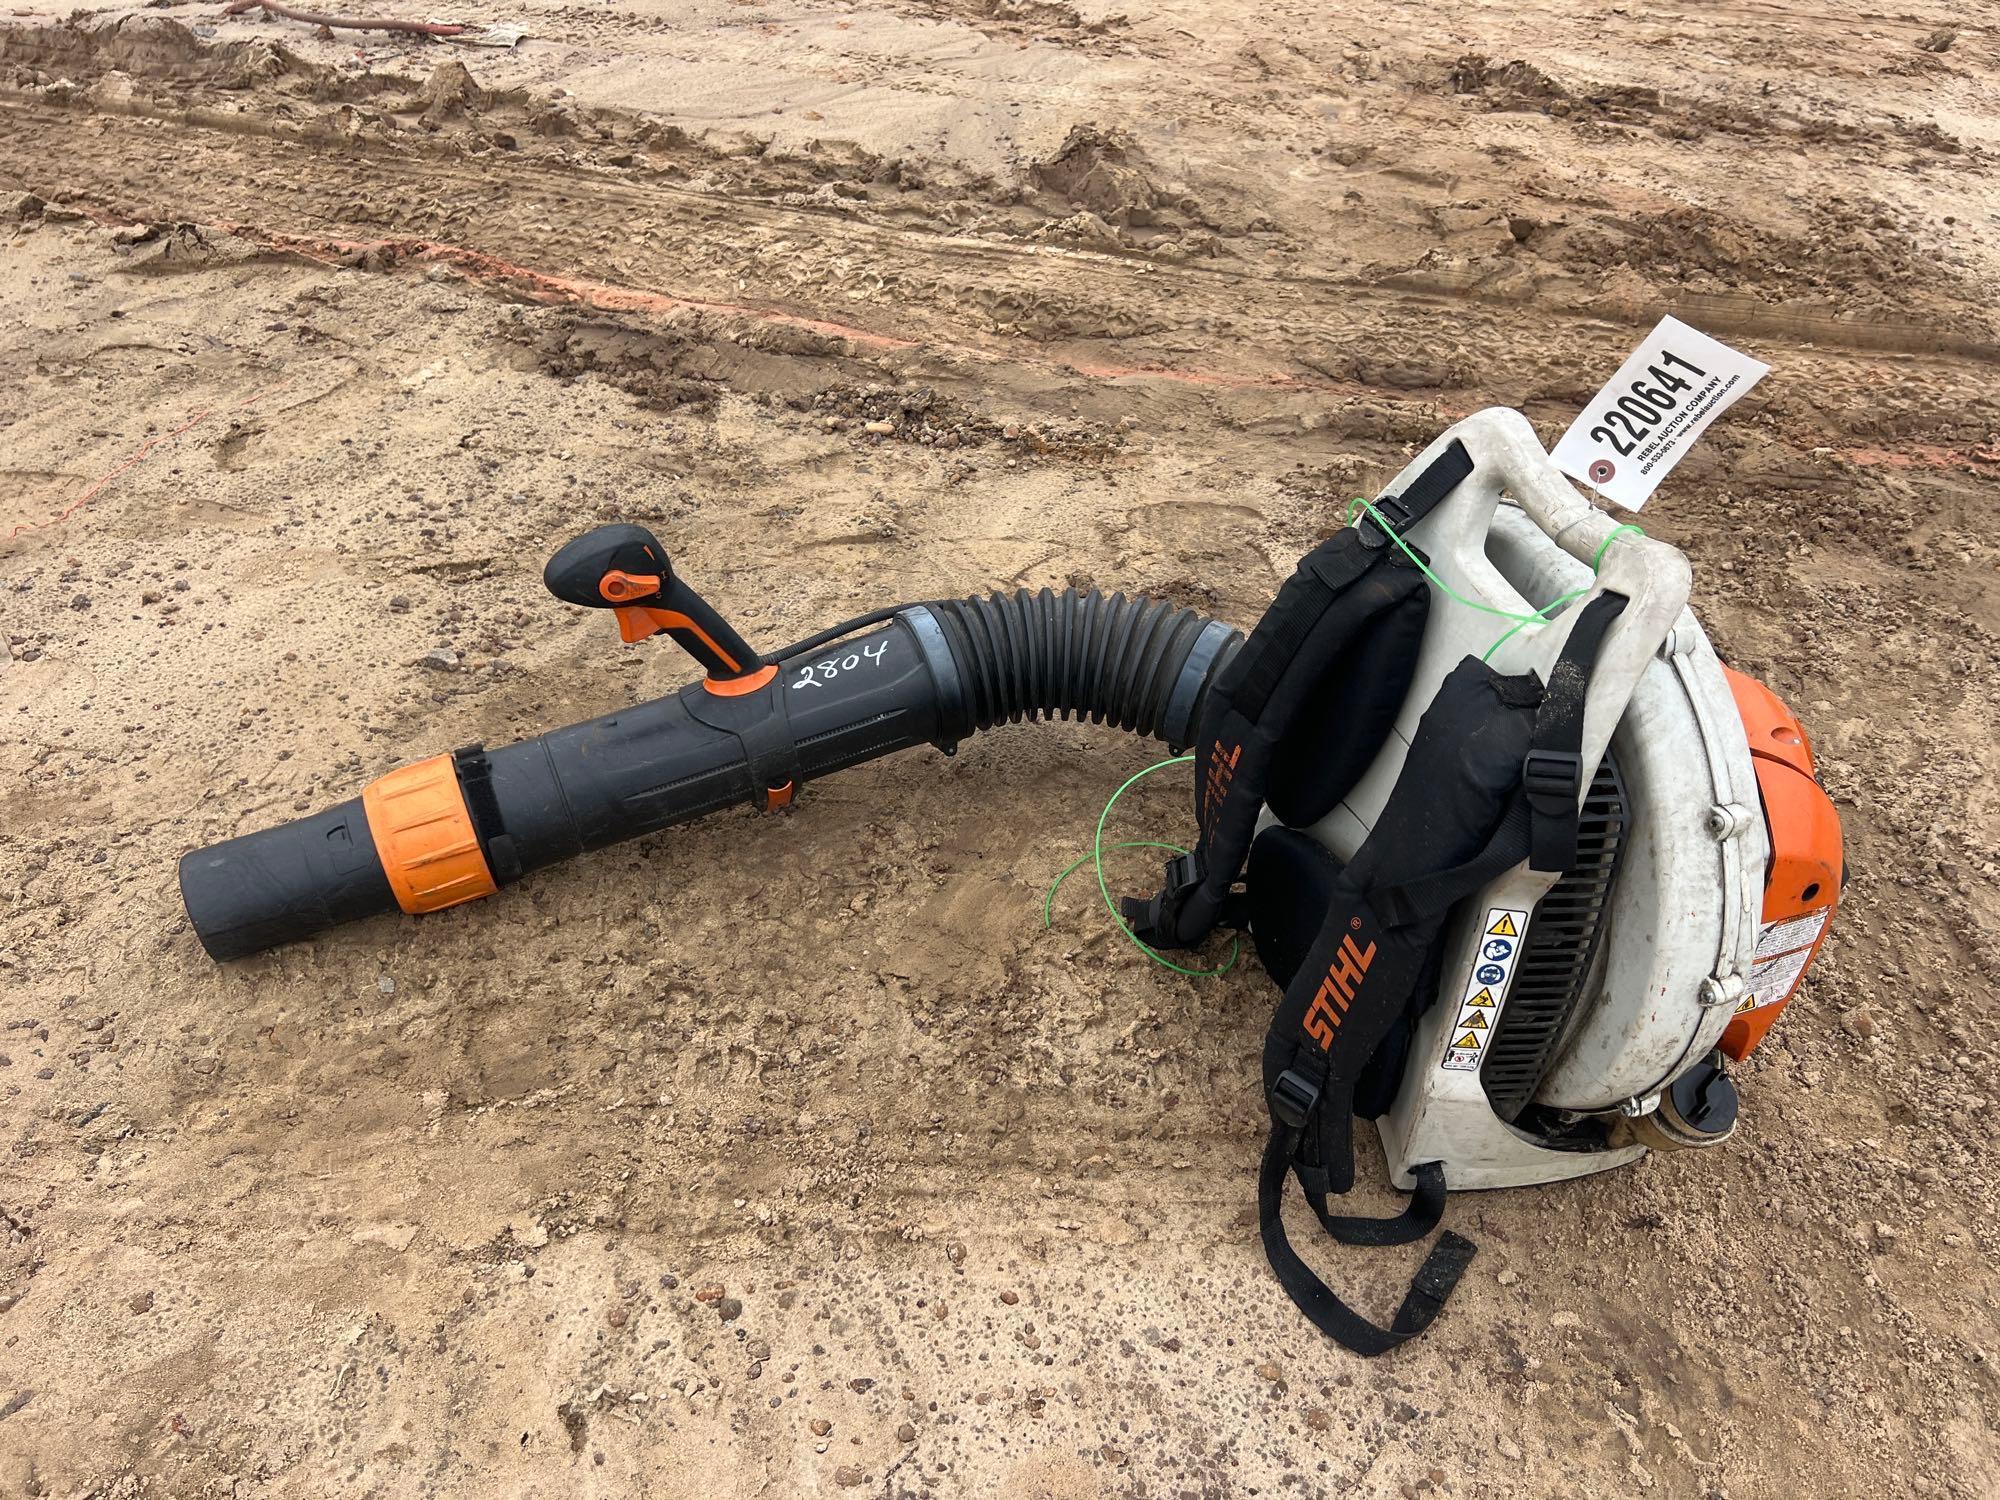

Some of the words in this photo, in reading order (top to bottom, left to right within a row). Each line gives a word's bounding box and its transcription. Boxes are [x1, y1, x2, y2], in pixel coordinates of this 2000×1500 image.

[1590, 350, 1706, 457] 220641
[1637, 441, 1660, 461] REBEL
[1657, 410, 1689, 442] AUCTION
[1685, 375, 1721, 412] COMPANY
[1676, 374, 1741, 438] www.rebelauction.com
[792, 640, 889, 689] 2804
[1302, 933, 1377, 1051] STIHL
